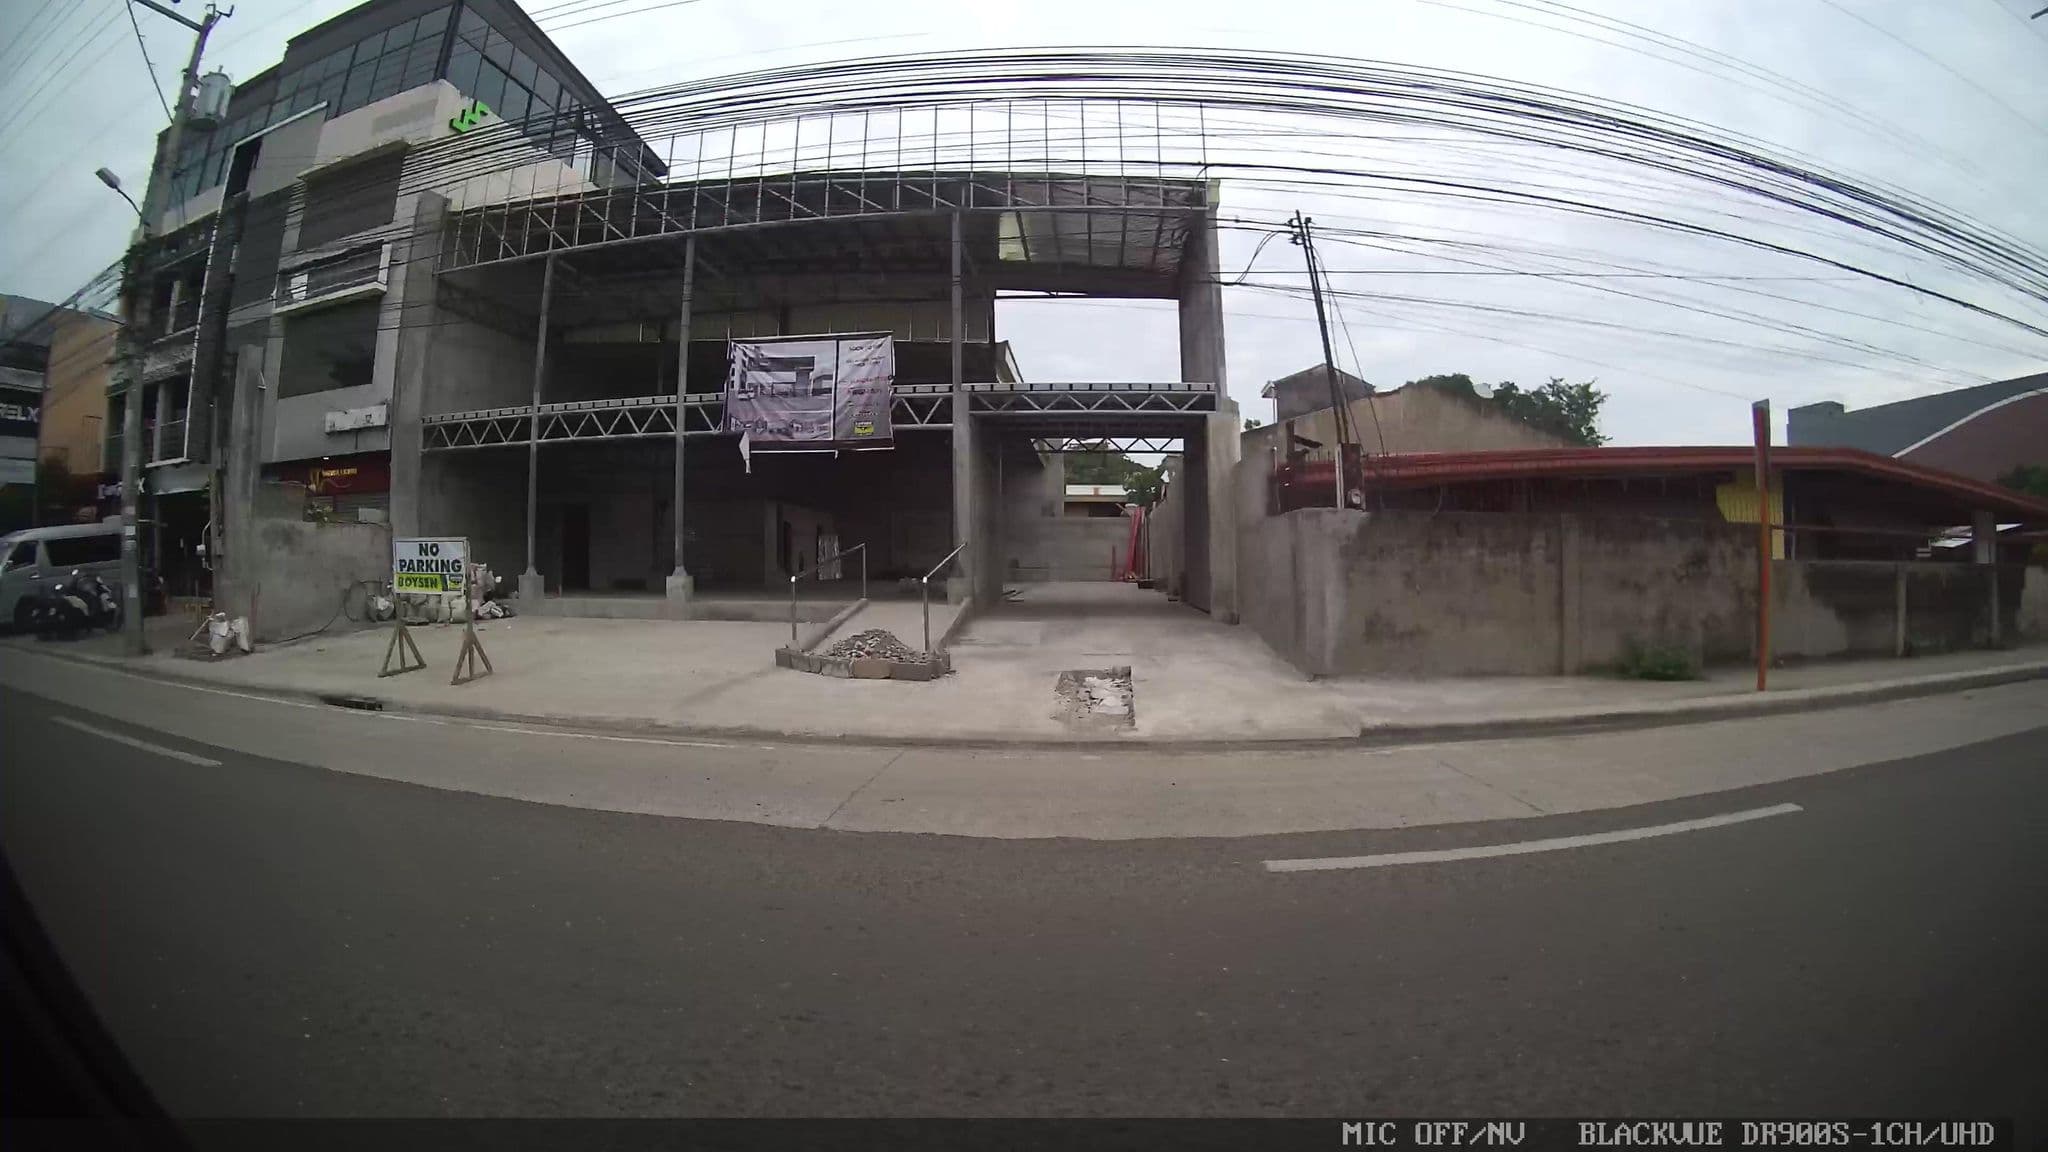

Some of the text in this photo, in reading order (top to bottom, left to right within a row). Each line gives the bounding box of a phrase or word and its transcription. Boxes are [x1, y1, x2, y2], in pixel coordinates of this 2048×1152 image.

[418, 543, 440, 556] NO
[399, 559, 462, 573] PARKING
[398, 576, 438, 589] BOYSEN
